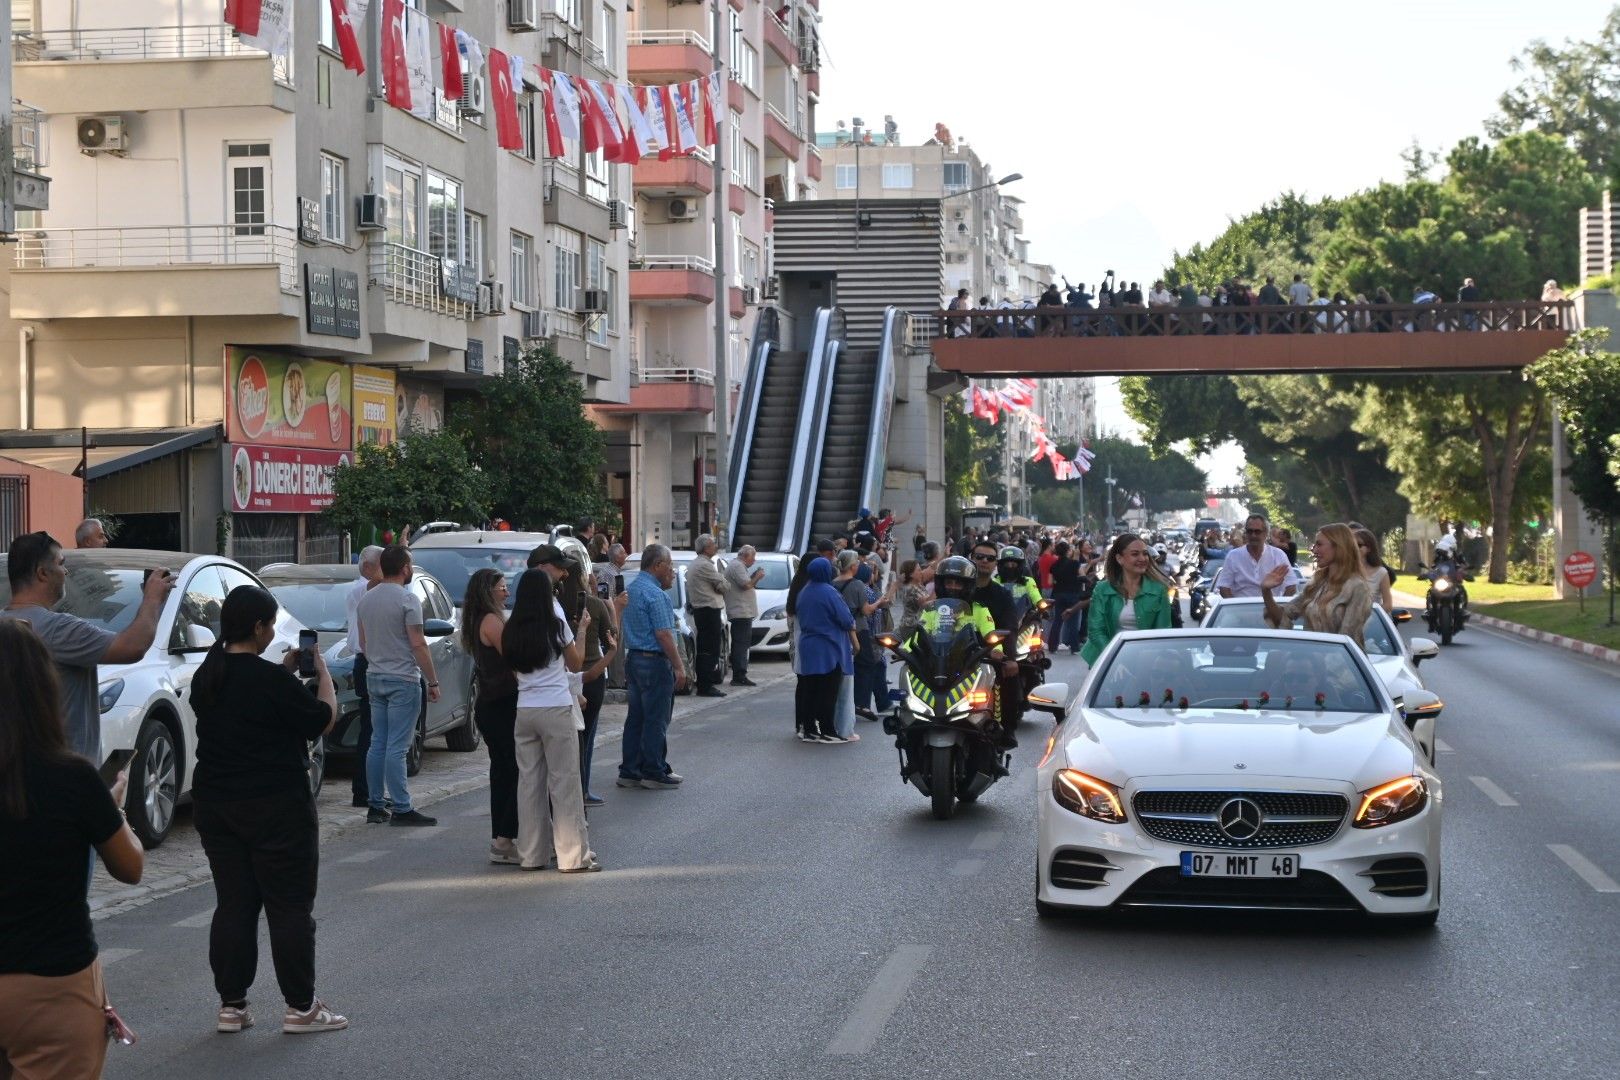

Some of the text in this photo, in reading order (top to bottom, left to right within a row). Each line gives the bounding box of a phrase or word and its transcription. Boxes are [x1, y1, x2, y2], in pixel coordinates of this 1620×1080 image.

[255, 453, 301, 494] DÖNERCİ
[1193, 855, 1293, 875] 07 MMT 48
